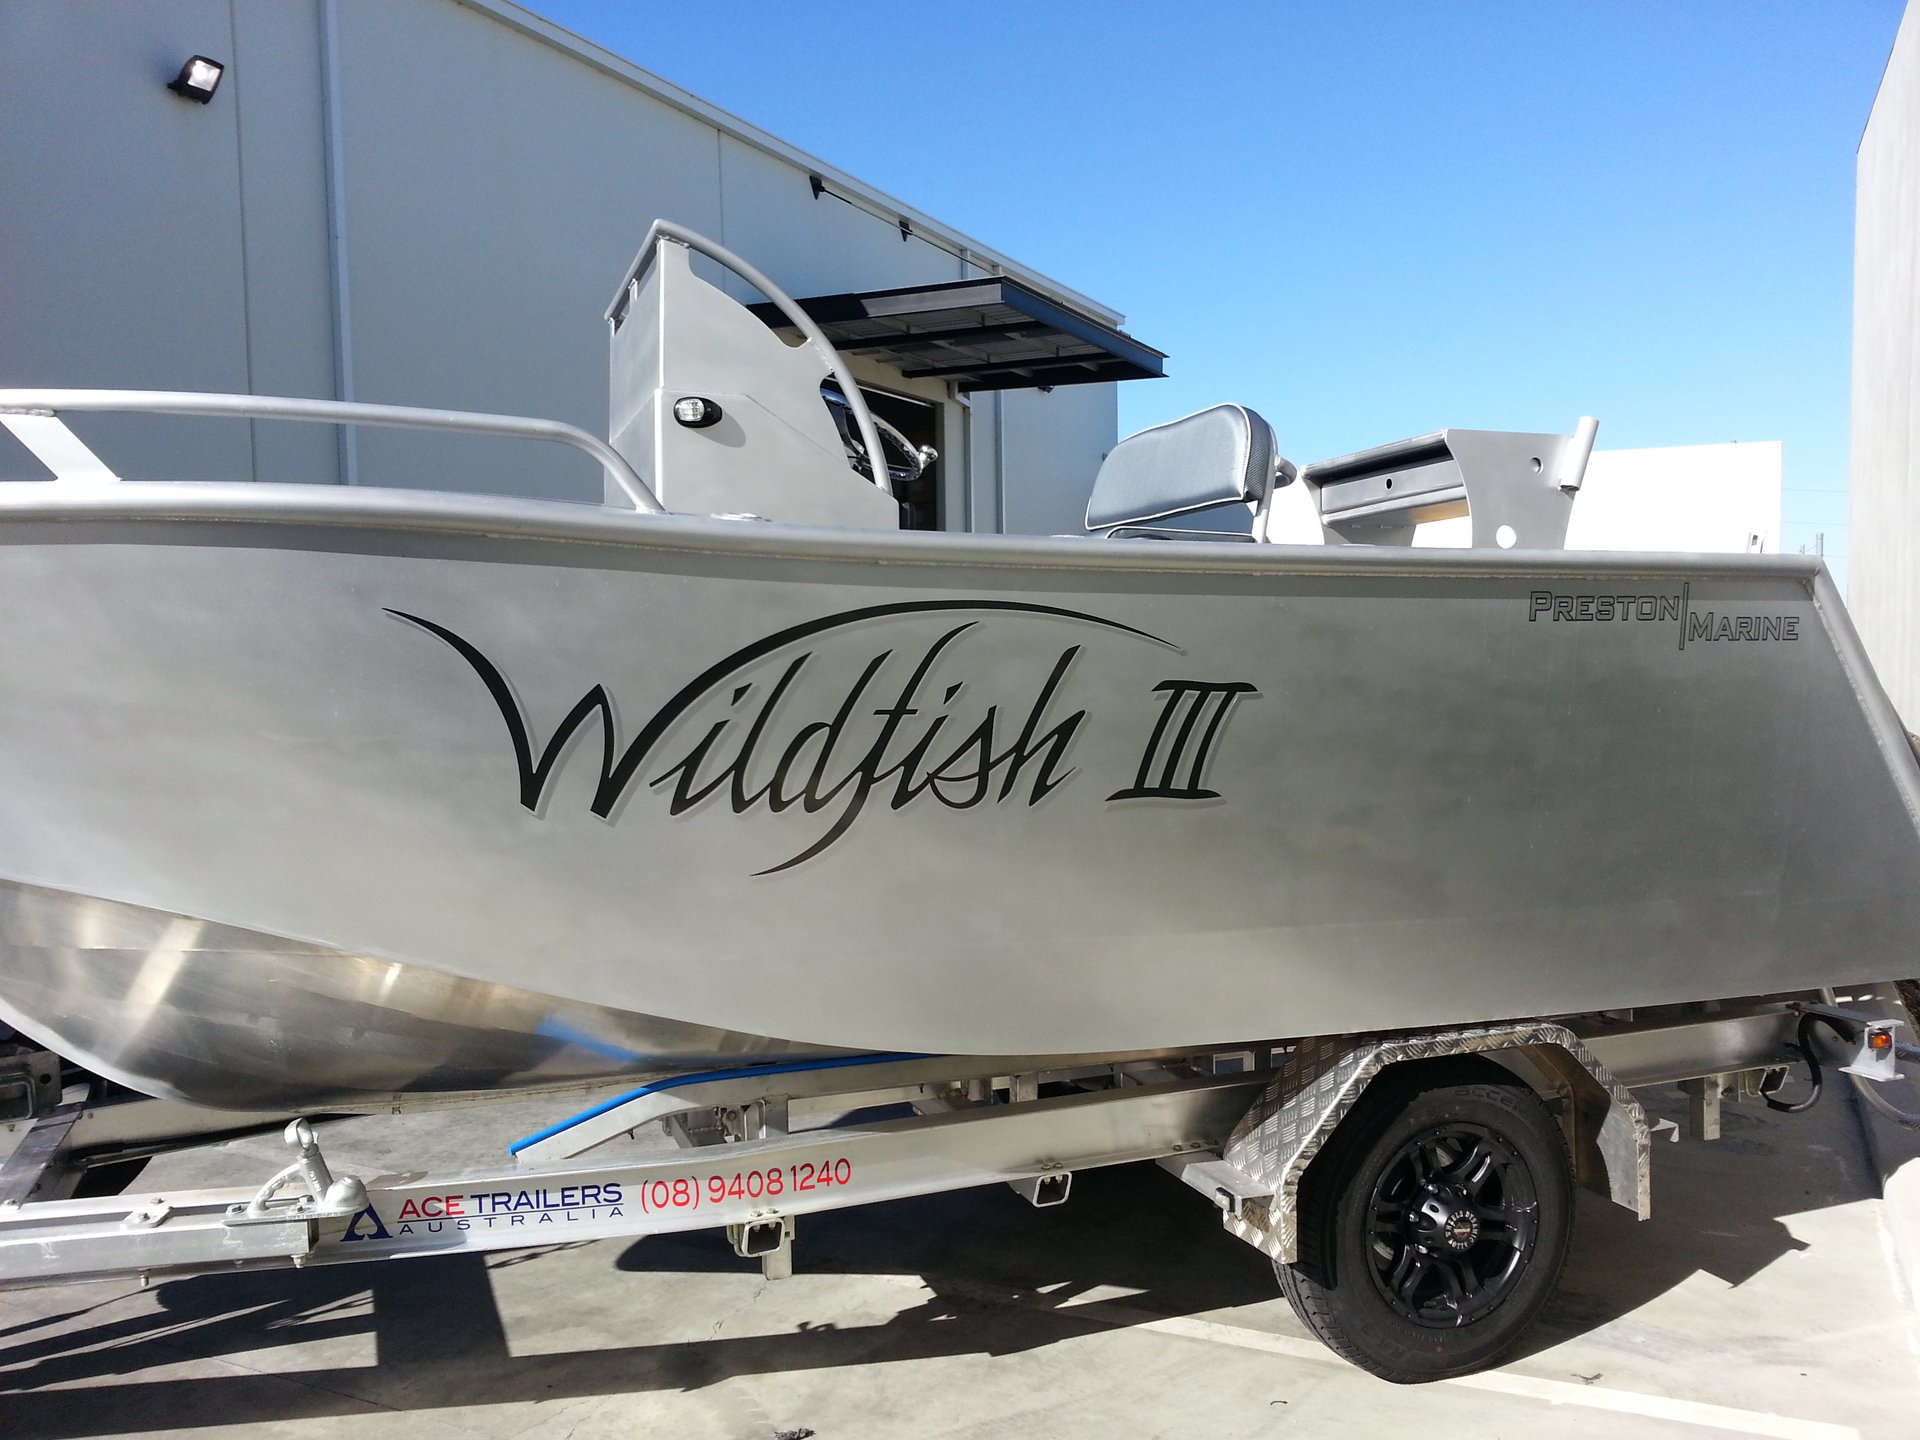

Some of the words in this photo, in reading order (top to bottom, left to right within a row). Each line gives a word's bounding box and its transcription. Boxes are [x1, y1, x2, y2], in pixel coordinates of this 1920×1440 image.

[1528, 590, 1681, 622] PRESTON
[1687, 611, 1801, 642] MARINE
[382, 600, 1181, 878] Wildfish
[1105, 679, 1260, 803] III
[399, 1194, 465, 1219] ACE
[469, 1182, 624, 1215] TRAILERS
[641, 1179, 701, 1215] (08)
[399, 1206, 625, 1235] AUSTRALIA
